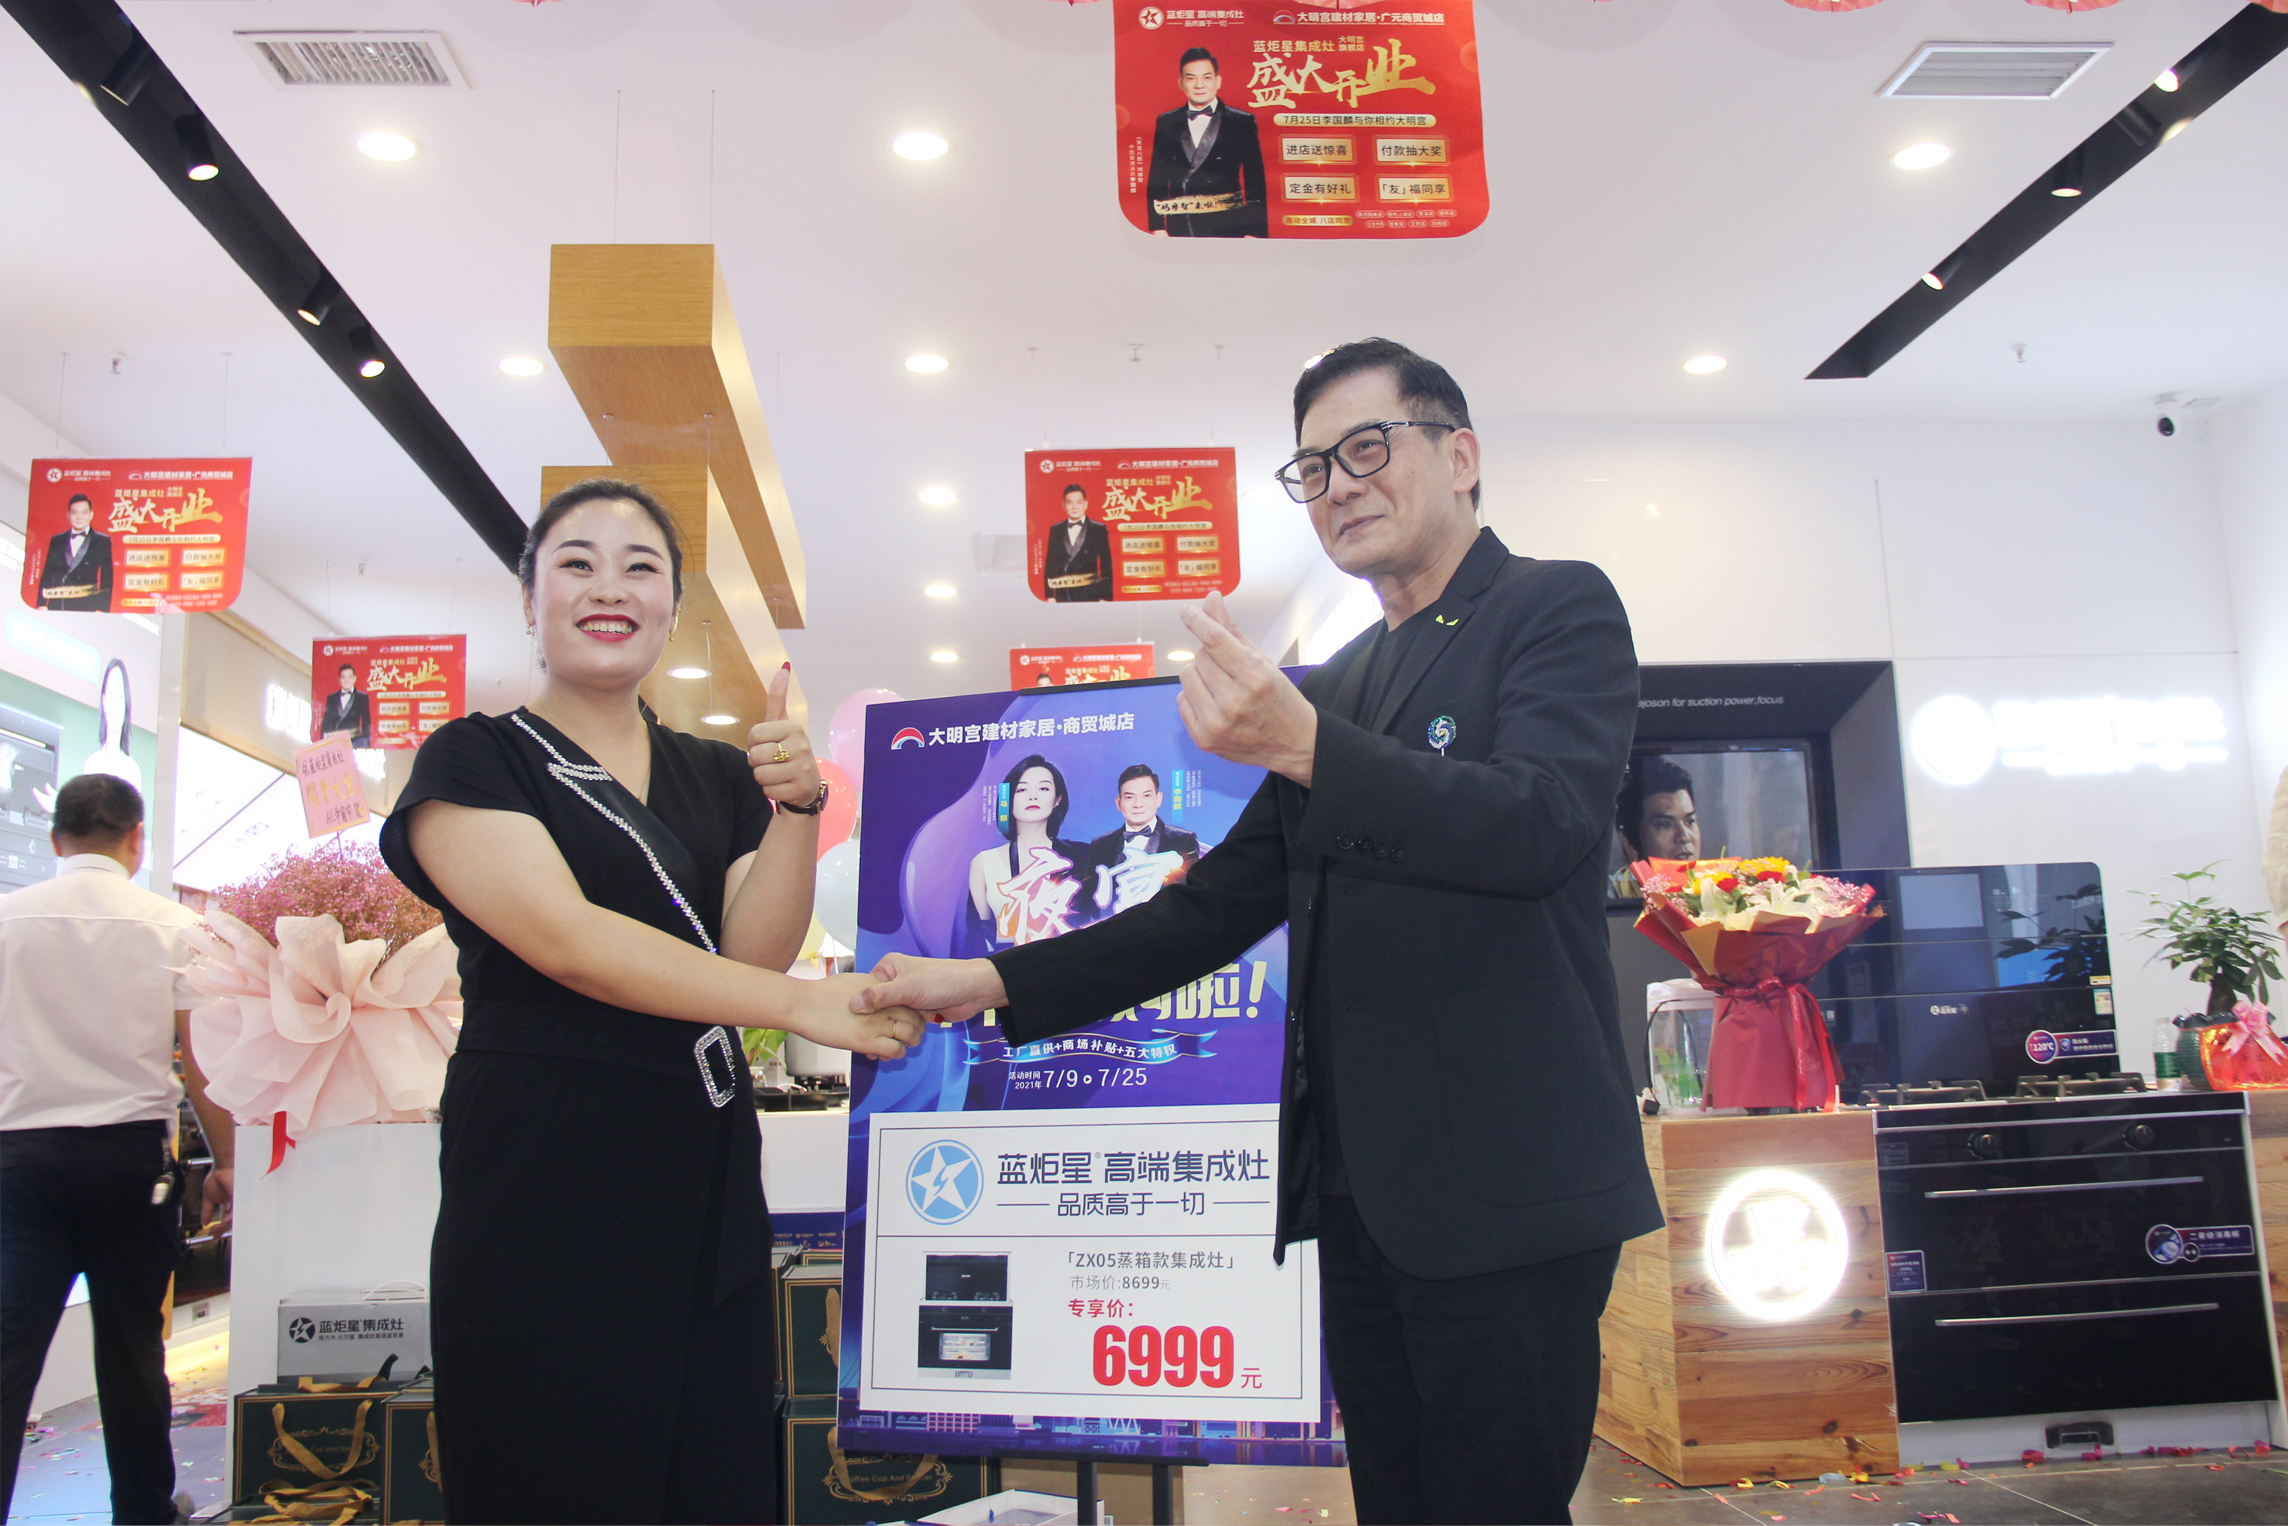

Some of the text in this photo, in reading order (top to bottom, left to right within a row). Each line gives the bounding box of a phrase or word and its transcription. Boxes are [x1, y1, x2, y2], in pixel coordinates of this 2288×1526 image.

[1253, 40, 1335, 52] 蓝炬星集成灶
[1246, 38, 1436, 109] 盛大开业
[1284, 115, 1427, 126] 7月25日李国麟与你相约大明宫
[1286, 144, 1347, 156] 进店送惊喜
[1381, 145, 1442, 157] 付款抽大奖
[1290, 183, 1351, 195] 定金有好礼
[1382, 183, 1446, 195] 「友」福同享
[1102, 476, 1213, 521] 盛大开业
[108, 487, 223, 533] 盛大开业
[1672, 698, 1685, 707] for
[1687, 698, 1722, 706] suction
[928, 712, 1135, 746] 大明宫建材家居·商贸城店
[1003, 1039, 1177, 1059] 工厂直供+商场补贴+五大特权
[1008, 1071, 1041, 1080] 活动时间
[1044, 1068, 1148, 1088] 7/9 7/25
[1015, 1081, 1042, 1090] 2021年
[1057, 1192, 1205, 1216] 品质高于一切
[1068, 1251, 1234, 1269] 「ZX05蒸箱款集成灶」
